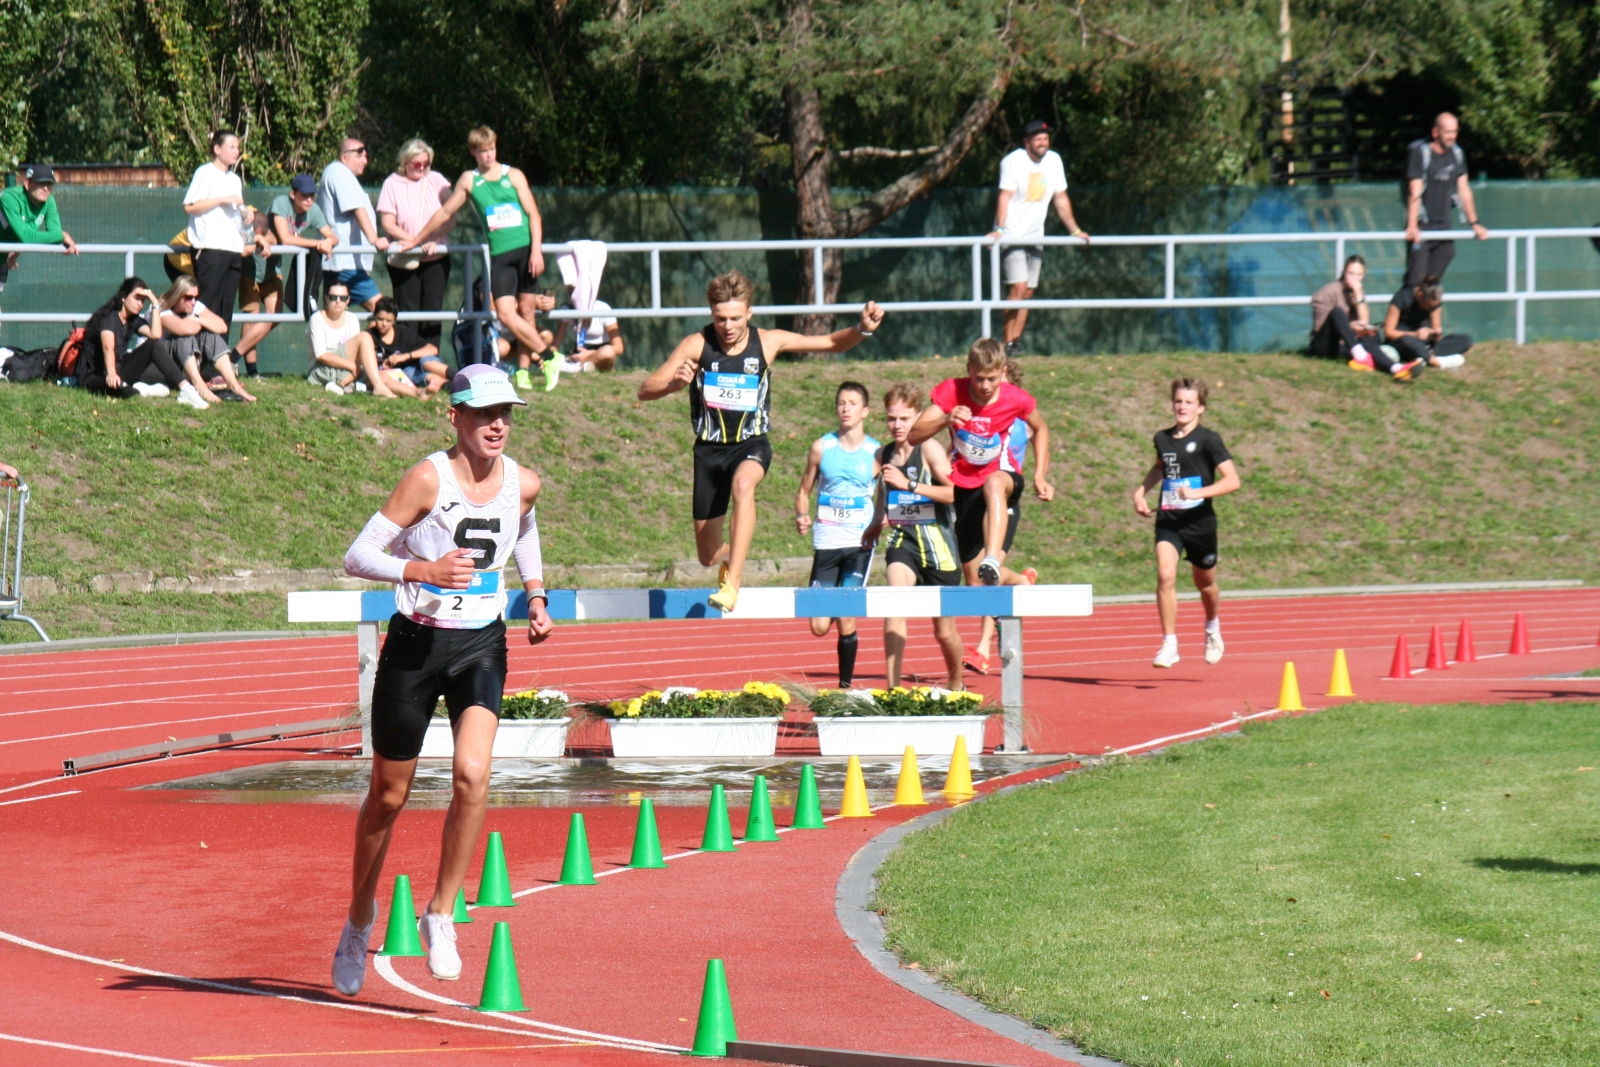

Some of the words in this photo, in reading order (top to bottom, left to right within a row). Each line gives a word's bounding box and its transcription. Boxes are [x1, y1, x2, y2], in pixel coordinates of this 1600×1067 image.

[719, 388, 742, 399] 263
[970, 446, 986, 457] 52
[832, 508, 851, 518] 185
[900, 506, 921, 516] 264
[451, 595, 463, 610] 2
